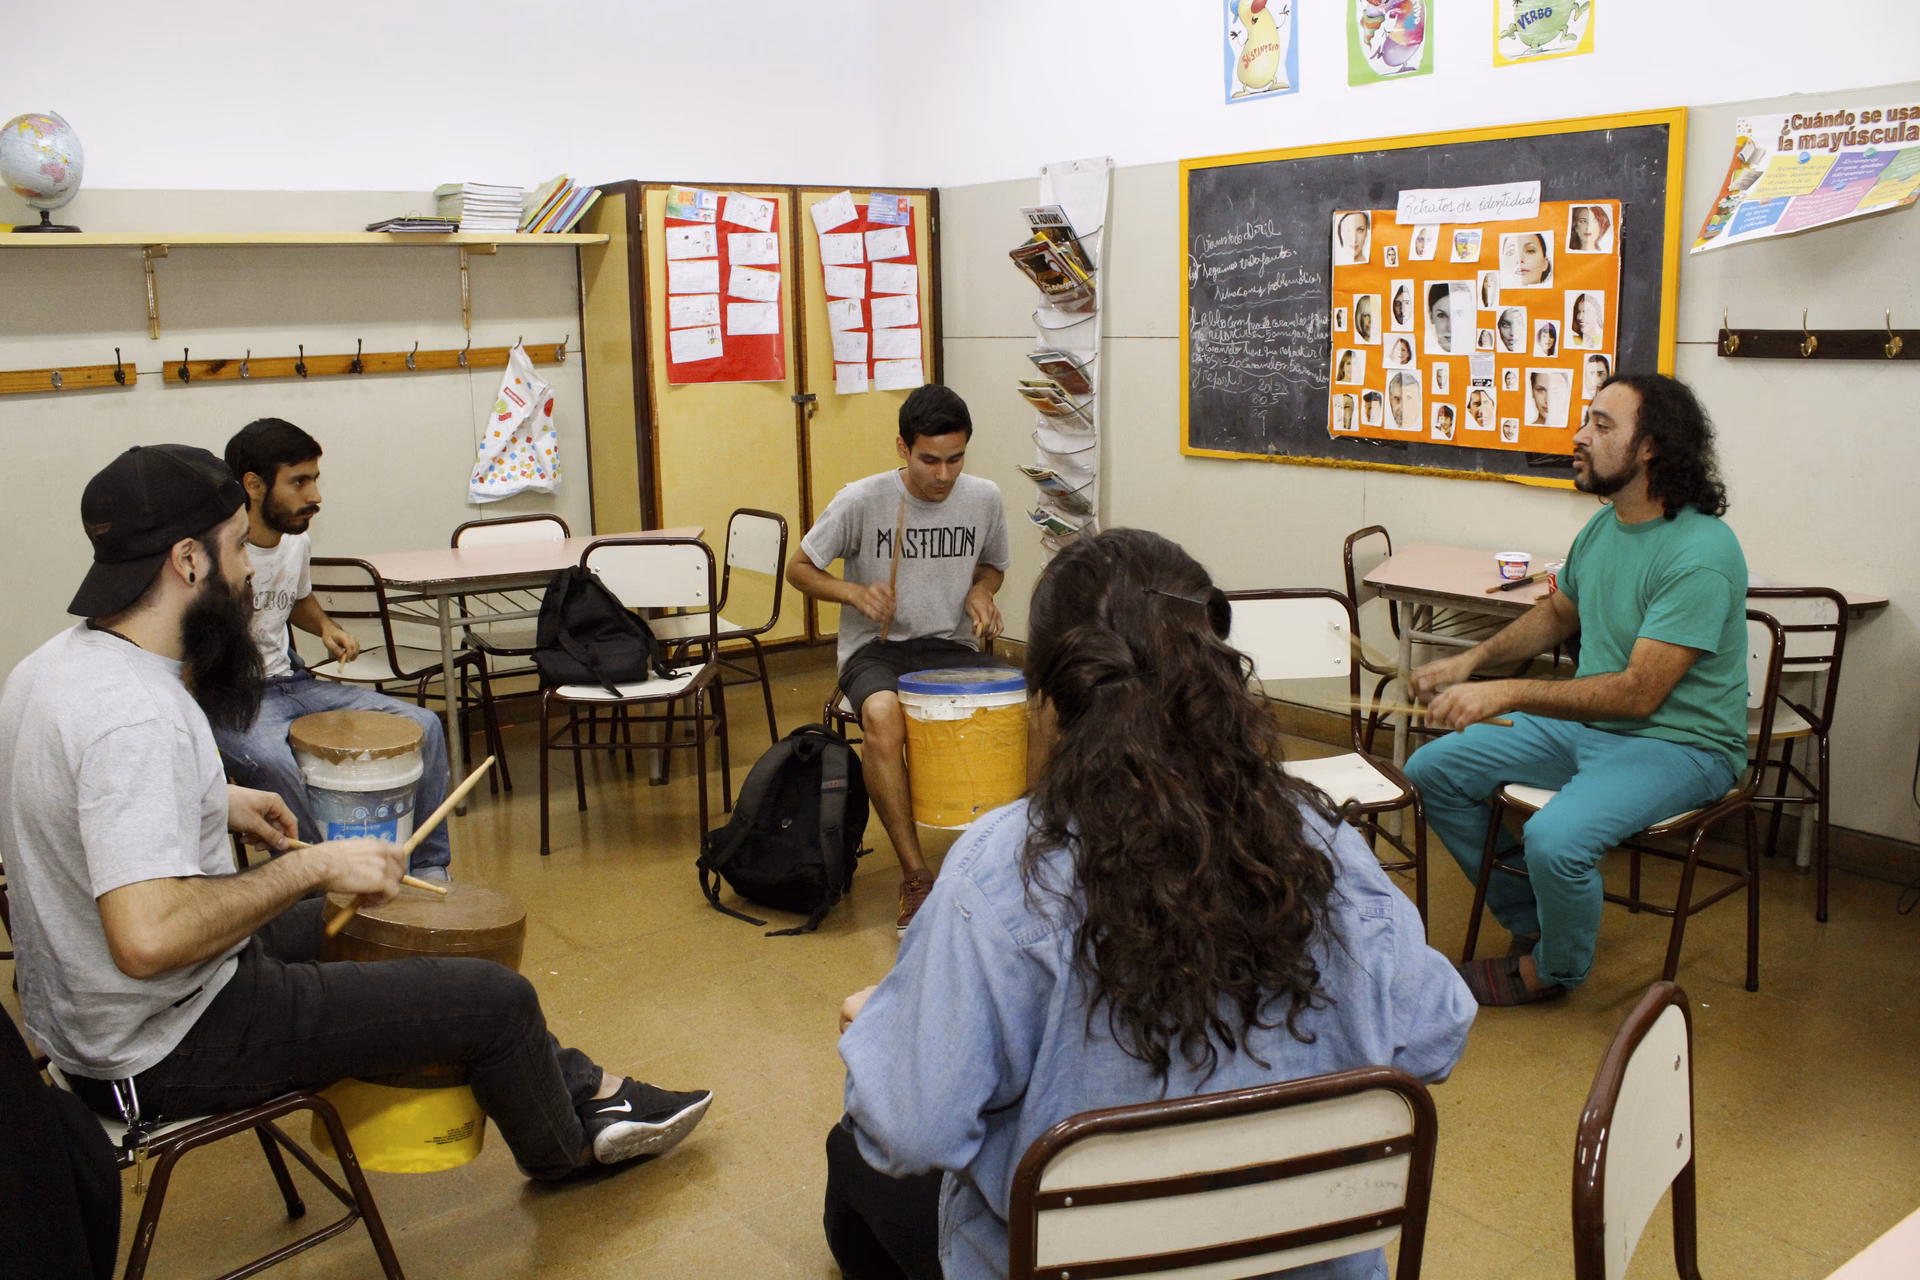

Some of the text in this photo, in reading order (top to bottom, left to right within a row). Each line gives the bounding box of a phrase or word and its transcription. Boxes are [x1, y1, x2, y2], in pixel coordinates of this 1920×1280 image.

[1517, 7, 1552, 30] VERBO
[1242, 43, 1279, 69] SUSTANTIVO
[1781, 105, 1920, 136] ¿Cuándo se usa
[1778, 121, 1920, 153] la mayúscula
[1404, 186, 1536, 220] Retratos de identidad
[1028, 214, 1040, 225] EL
[877, 527, 976, 558] MASTODON
